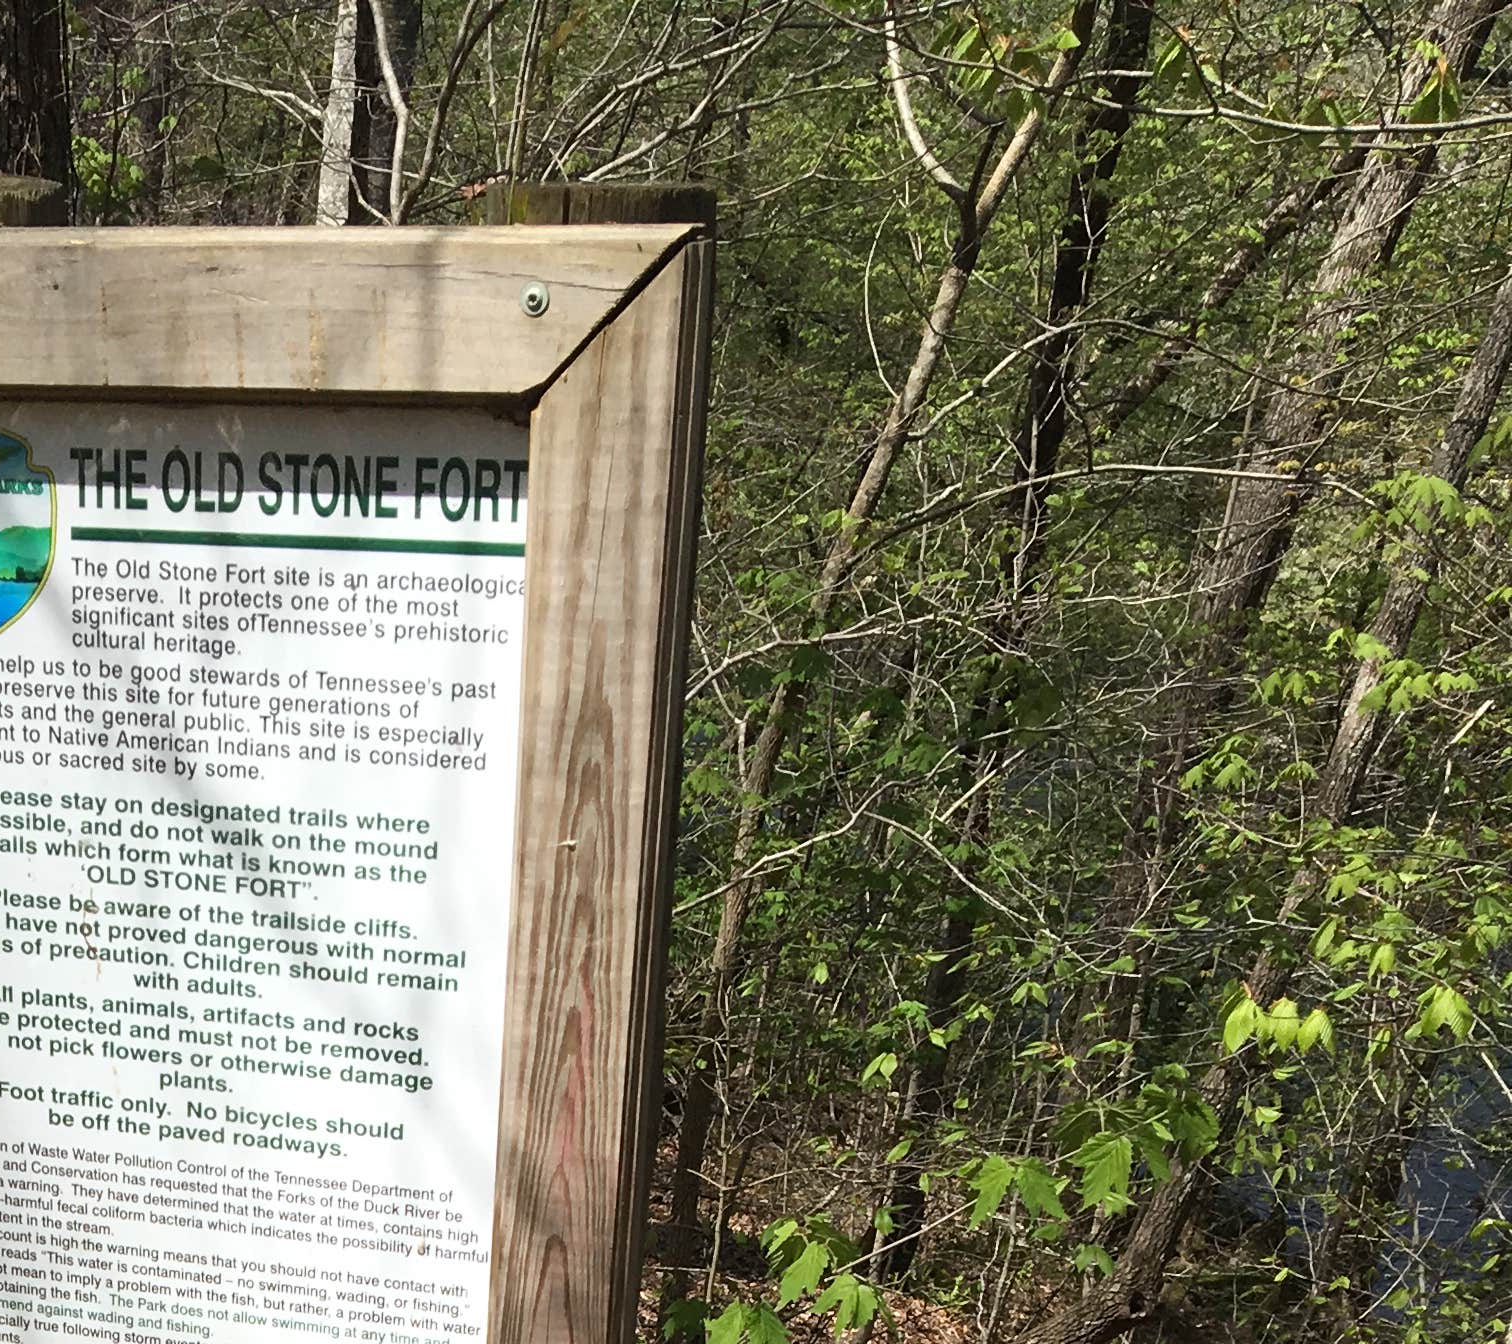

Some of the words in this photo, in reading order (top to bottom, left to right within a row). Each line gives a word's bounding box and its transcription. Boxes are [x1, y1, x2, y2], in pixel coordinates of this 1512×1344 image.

[69, 446, 147, 509] THE
[161, 447, 244, 512] OLD
[258, 450, 399, 516] STONE
[414, 455, 530, 523] FORT
[70, 556, 108, 579] The
[115, 558, 150, 580] Old
[158, 559, 217, 583] Stone
[225, 562, 265, 585] Fort
[273, 565, 310, 586] site
[318, 566, 335, 587] is
[343, 572, 368, 592] an
[71, 585, 164, 605] preserve.
[178, 585, 191, 605] It
[198, 588, 283, 611] protects
[290, 594, 329, 611] one
[337, 592, 357, 612] of
[365, 594, 397, 614] the
[406, 599, 458, 617] most
[71, 604, 174, 632] significant
[181, 609, 229, 631] sites
[393, 621, 508, 644] prehistoric
[71, 625, 145, 650] cultural
[153, 631, 241, 660] heritage.
[42, 660, 65, 676] us
[71, 658, 91, 678] to
[98, 658, 123, 679] be
[129, 663, 181, 688] good
[188, 665, 280, 688] stewards
[287, 669, 307, 689] of
[315, 670, 442, 696] Tennessee's
[450, 681, 496, 702] past
[20, 702, 56, 721] and
[63, 703, 94, 724] the
[101, 709, 175, 730] general
[183, 711, 250, 734] public.
[259, 712, 301, 736] This
[309, 718, 345, 739] site
[353, 720, 369, 740] is
[377, 725, 483, 751] especially
[21, 724, 41, 743] to
[48, 725, 109, 748] Native
[115, 729, 209, 753] American
[217, 735, 290, 759] Indians
[298, 742, 335, 762] and
[344, 743, 361, 763] is
[369, 748, 486, 771] considered
[60, 791, 107, 816] stay
[114, 797, 143, 814] on
[150, 796, 280, 824] designated
[288, 807, 347, 828] trails
[355, 812, 430, 834] where
[79, 818, 122, 837] and
[129, 819, 159, 840] do
[167, 824, 203, 843] not
[210, 827, 264, 847] walk
[271, 833, 301, 850] on
[308, 832, 346, 853] the
[354, 840, 438, 860] mound
[143, 868, 226, 893] STONE
[68, 893, 99, 917] be
[103, 900, 171, 919] aware
[178, 903, 201, 922] of
[207, 905, 244, 925] the
[250, 909, 346, 934] trailside
[353, 917, 417, 940] cliffs.
[5, 911, 57, 934] have
[65, 920, 100, 944] not
[107, 924, 186, 944] proved
[193, 928, 318, 956] dangerous
[325, 940, 373, 960] with
[383, 948, 465, 968] normal
[20, 937, 42, 955] of
[49, 938, 174, 967] precaution.
[182, 950, 280, 976] Children
[288, 960, 368, 984] should
[377, 972, 458, 992] remain
[132, 970, 179, 991] with
[186, 976, 262, 998] adults.
[21, 987, 94, 1013] plants,
[101, 996, 195, 1023] animals,
[202, 1006, 295, 1029] artifacts
[302, 1016, 345, 1034] and
[353, 1021, 419, 1042] rocks
[17, 1013, 121, 1036] protected
[129, 1023, 170, 1041] and
[177, 1028, 233, 1047] must
[241, 1034, 277, 1051] not
[284, 1035, 312, 1055] be
[320, 1043, 429, 1066] removed.
[47, 1107, 74, 1127] be
[81, 1113, 110, 1131] off
[116, 1116, 151, 1135] the
[158, 1124, 225, 1144] paved
[233, 1132, 347, 1159] roadways.
[50, 1087, 113, 1109] traffic
[120, 1096, 171, 1119] only.
[186, 1100, 217, 1120] No
[224, 1104, 317, 1131] bicycles
[325, 1117, 403, 1140] should
[11, 1141, 24, 1154] of
[27, 1141, 68, 1159] Waste
[71, 1146, 110, 1164] Water
[114, 1151, 173, 1171] Pollution
[176, 1158, 227, 1177] Control
[230, 1166, 244, 1179] of
[247, 1167, 269, 1182] the
[273, 1169, 347, 1191] Tennessee
[351, 1179, 434, 1201] Department
[438, 1189, 453, 1202] of
[33, 1317, 59, 1333] true
[61, 1321, 120, 1344] following
[36, 1303, 83, 1319] against
[86, 1310, 134, 1329] wading
[137, 1317, 162, 1330] and
[165, 1318, 213, 1339] fishing.
